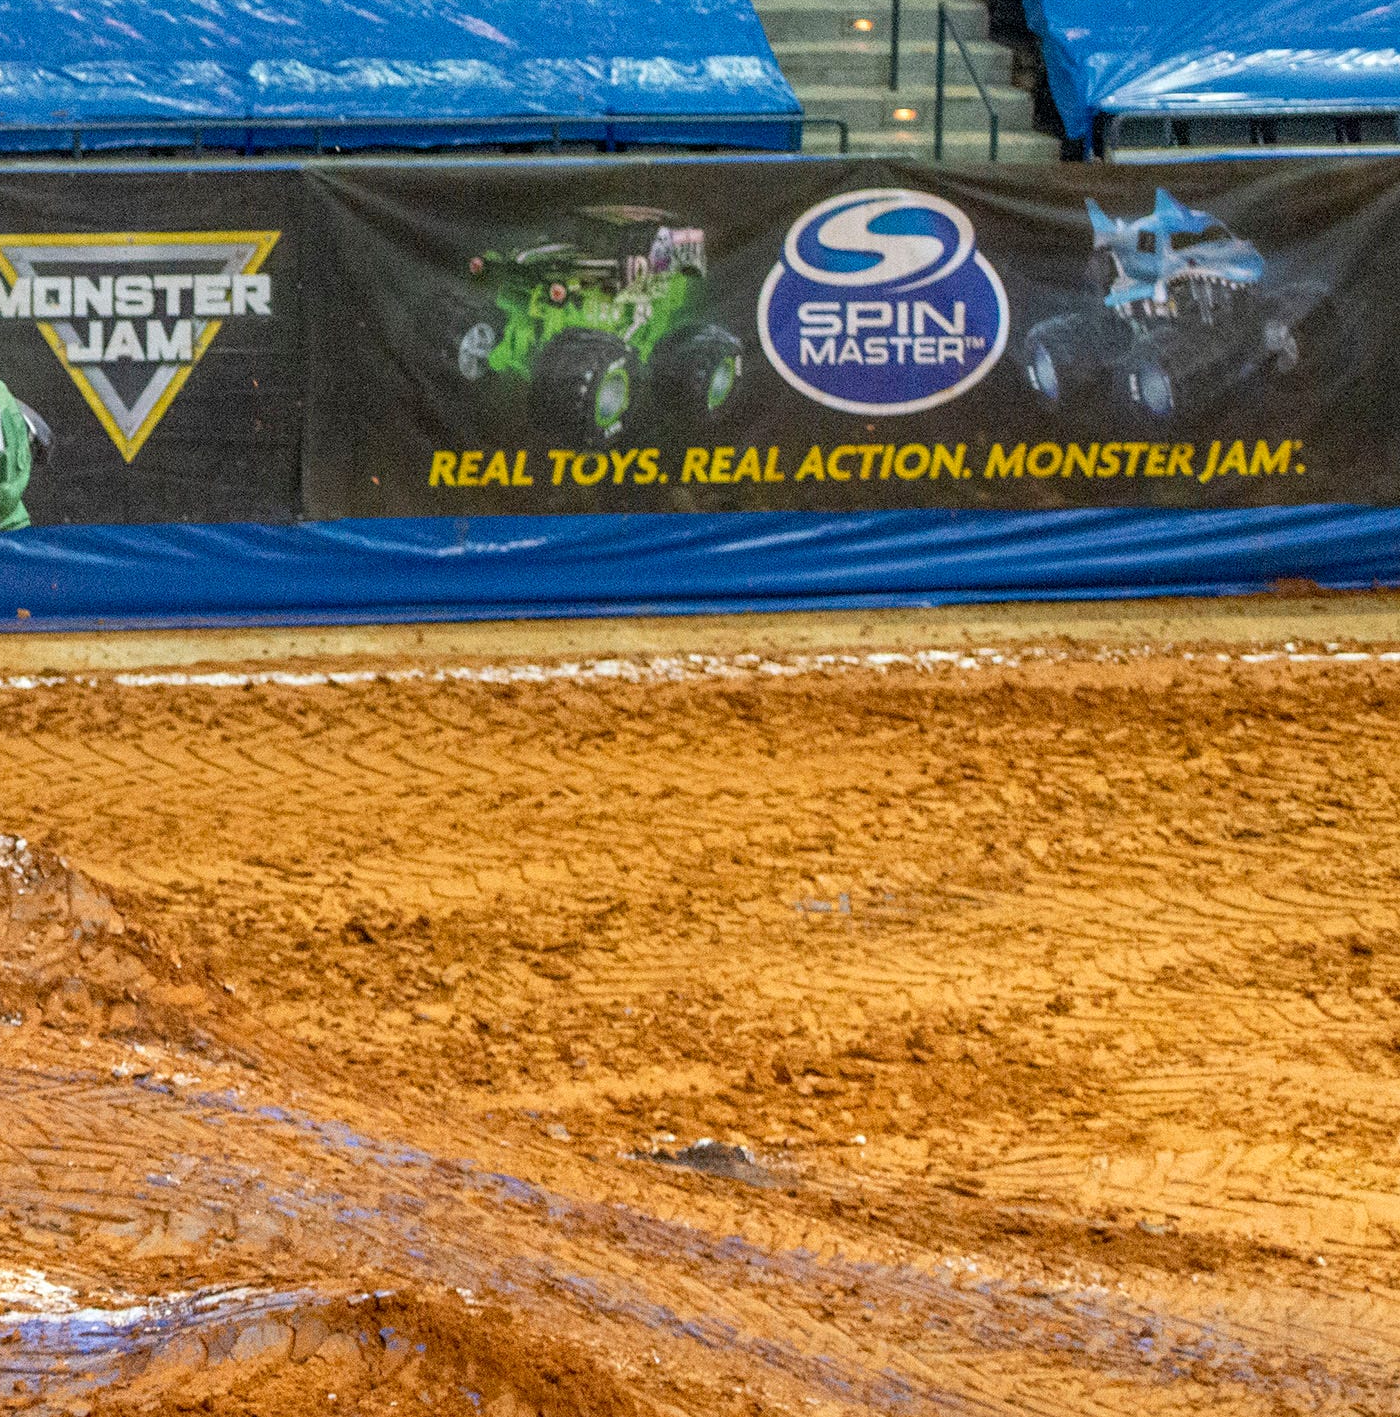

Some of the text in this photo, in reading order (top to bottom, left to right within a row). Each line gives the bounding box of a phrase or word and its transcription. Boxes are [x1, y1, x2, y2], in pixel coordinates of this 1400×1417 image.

[66, 319, 194, 363] JAM
[797, 301, 966, 338] SPIN
[428, 449, 534, 487] REAL
[547, 447, 668, 485] TOYS.
[680, 445, 786, 483] REAL
[795, 442, 973, 482] ACTION.
[983, 442, 1196, 479] MONSTER
